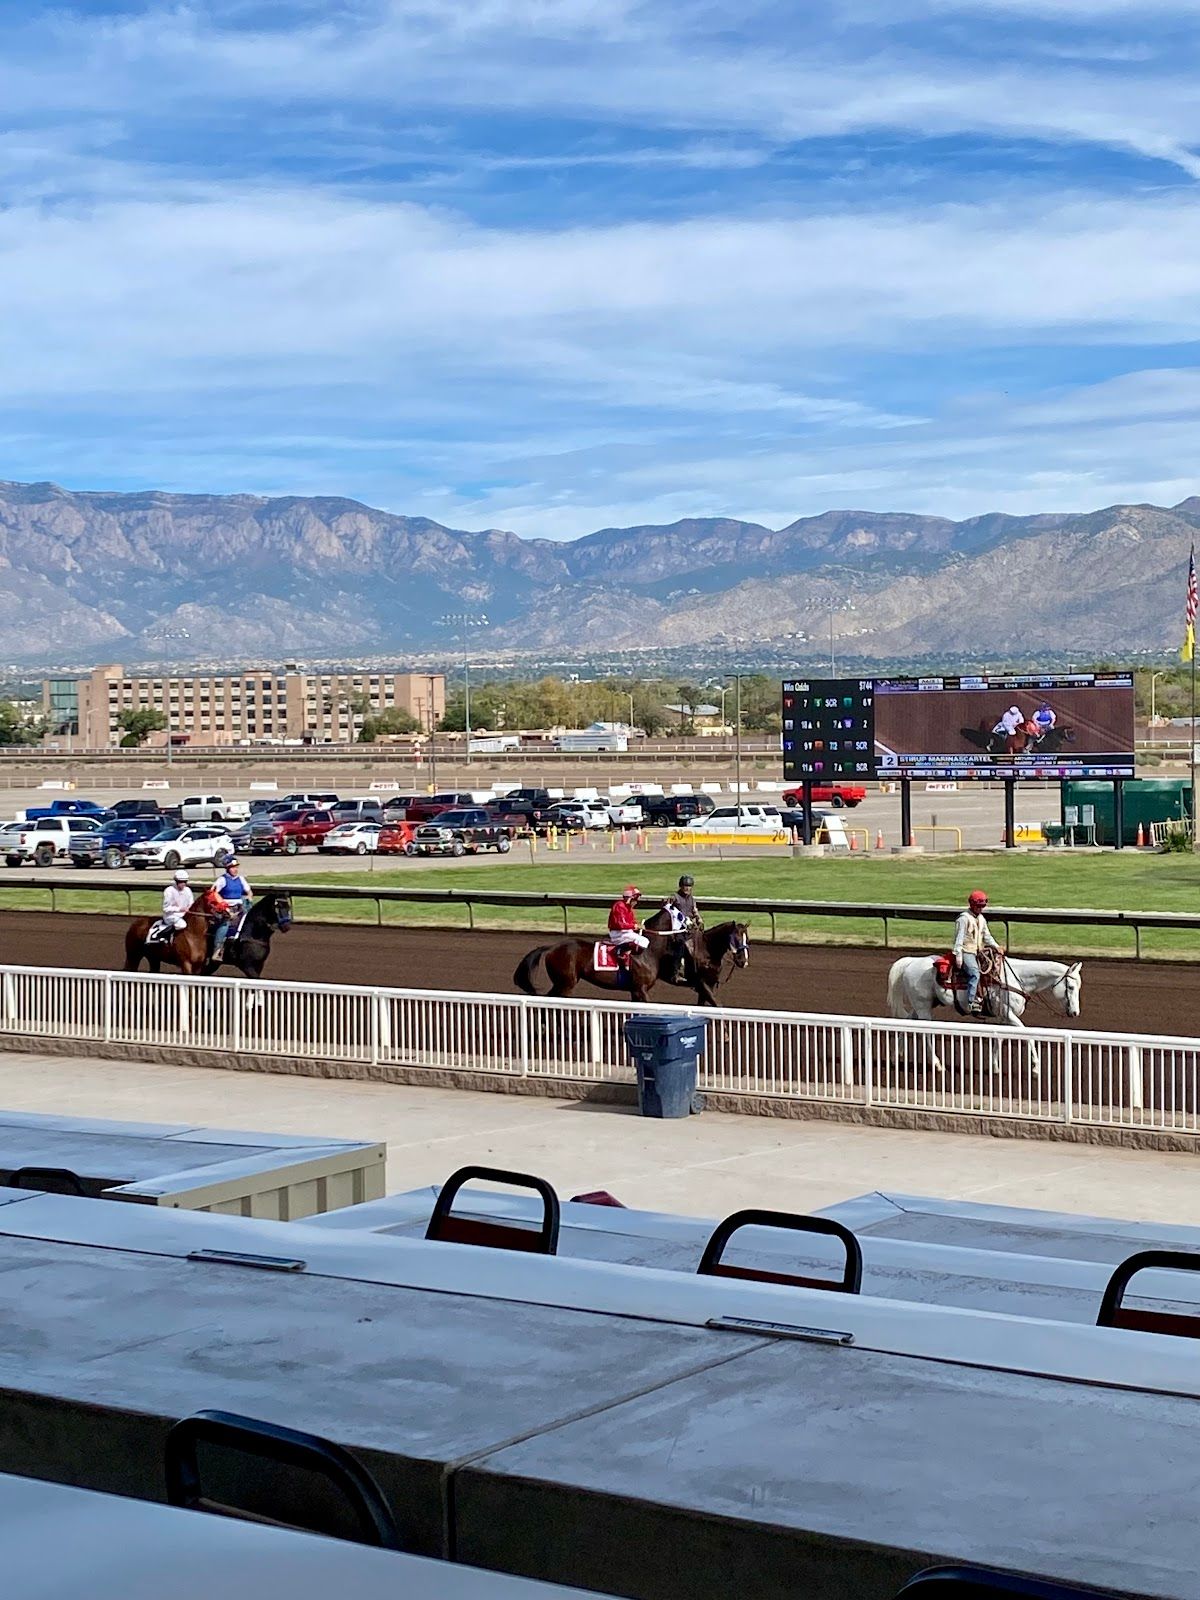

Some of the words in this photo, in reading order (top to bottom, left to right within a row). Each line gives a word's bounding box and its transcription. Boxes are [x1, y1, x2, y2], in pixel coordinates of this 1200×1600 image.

[825, 699, 838, 708] SCR
[863, 719, 868, 729] 2
[855, 741, 868, 751] SCR
[886, 757, 894, 766] 2
[855, 762, 869, 772] SCR
[670, 829, 684, 841] 20
[772, 829, 786, 842] 20
[1016, 824, 1029, 838] 21
[150, 924, 160, 941] 2
